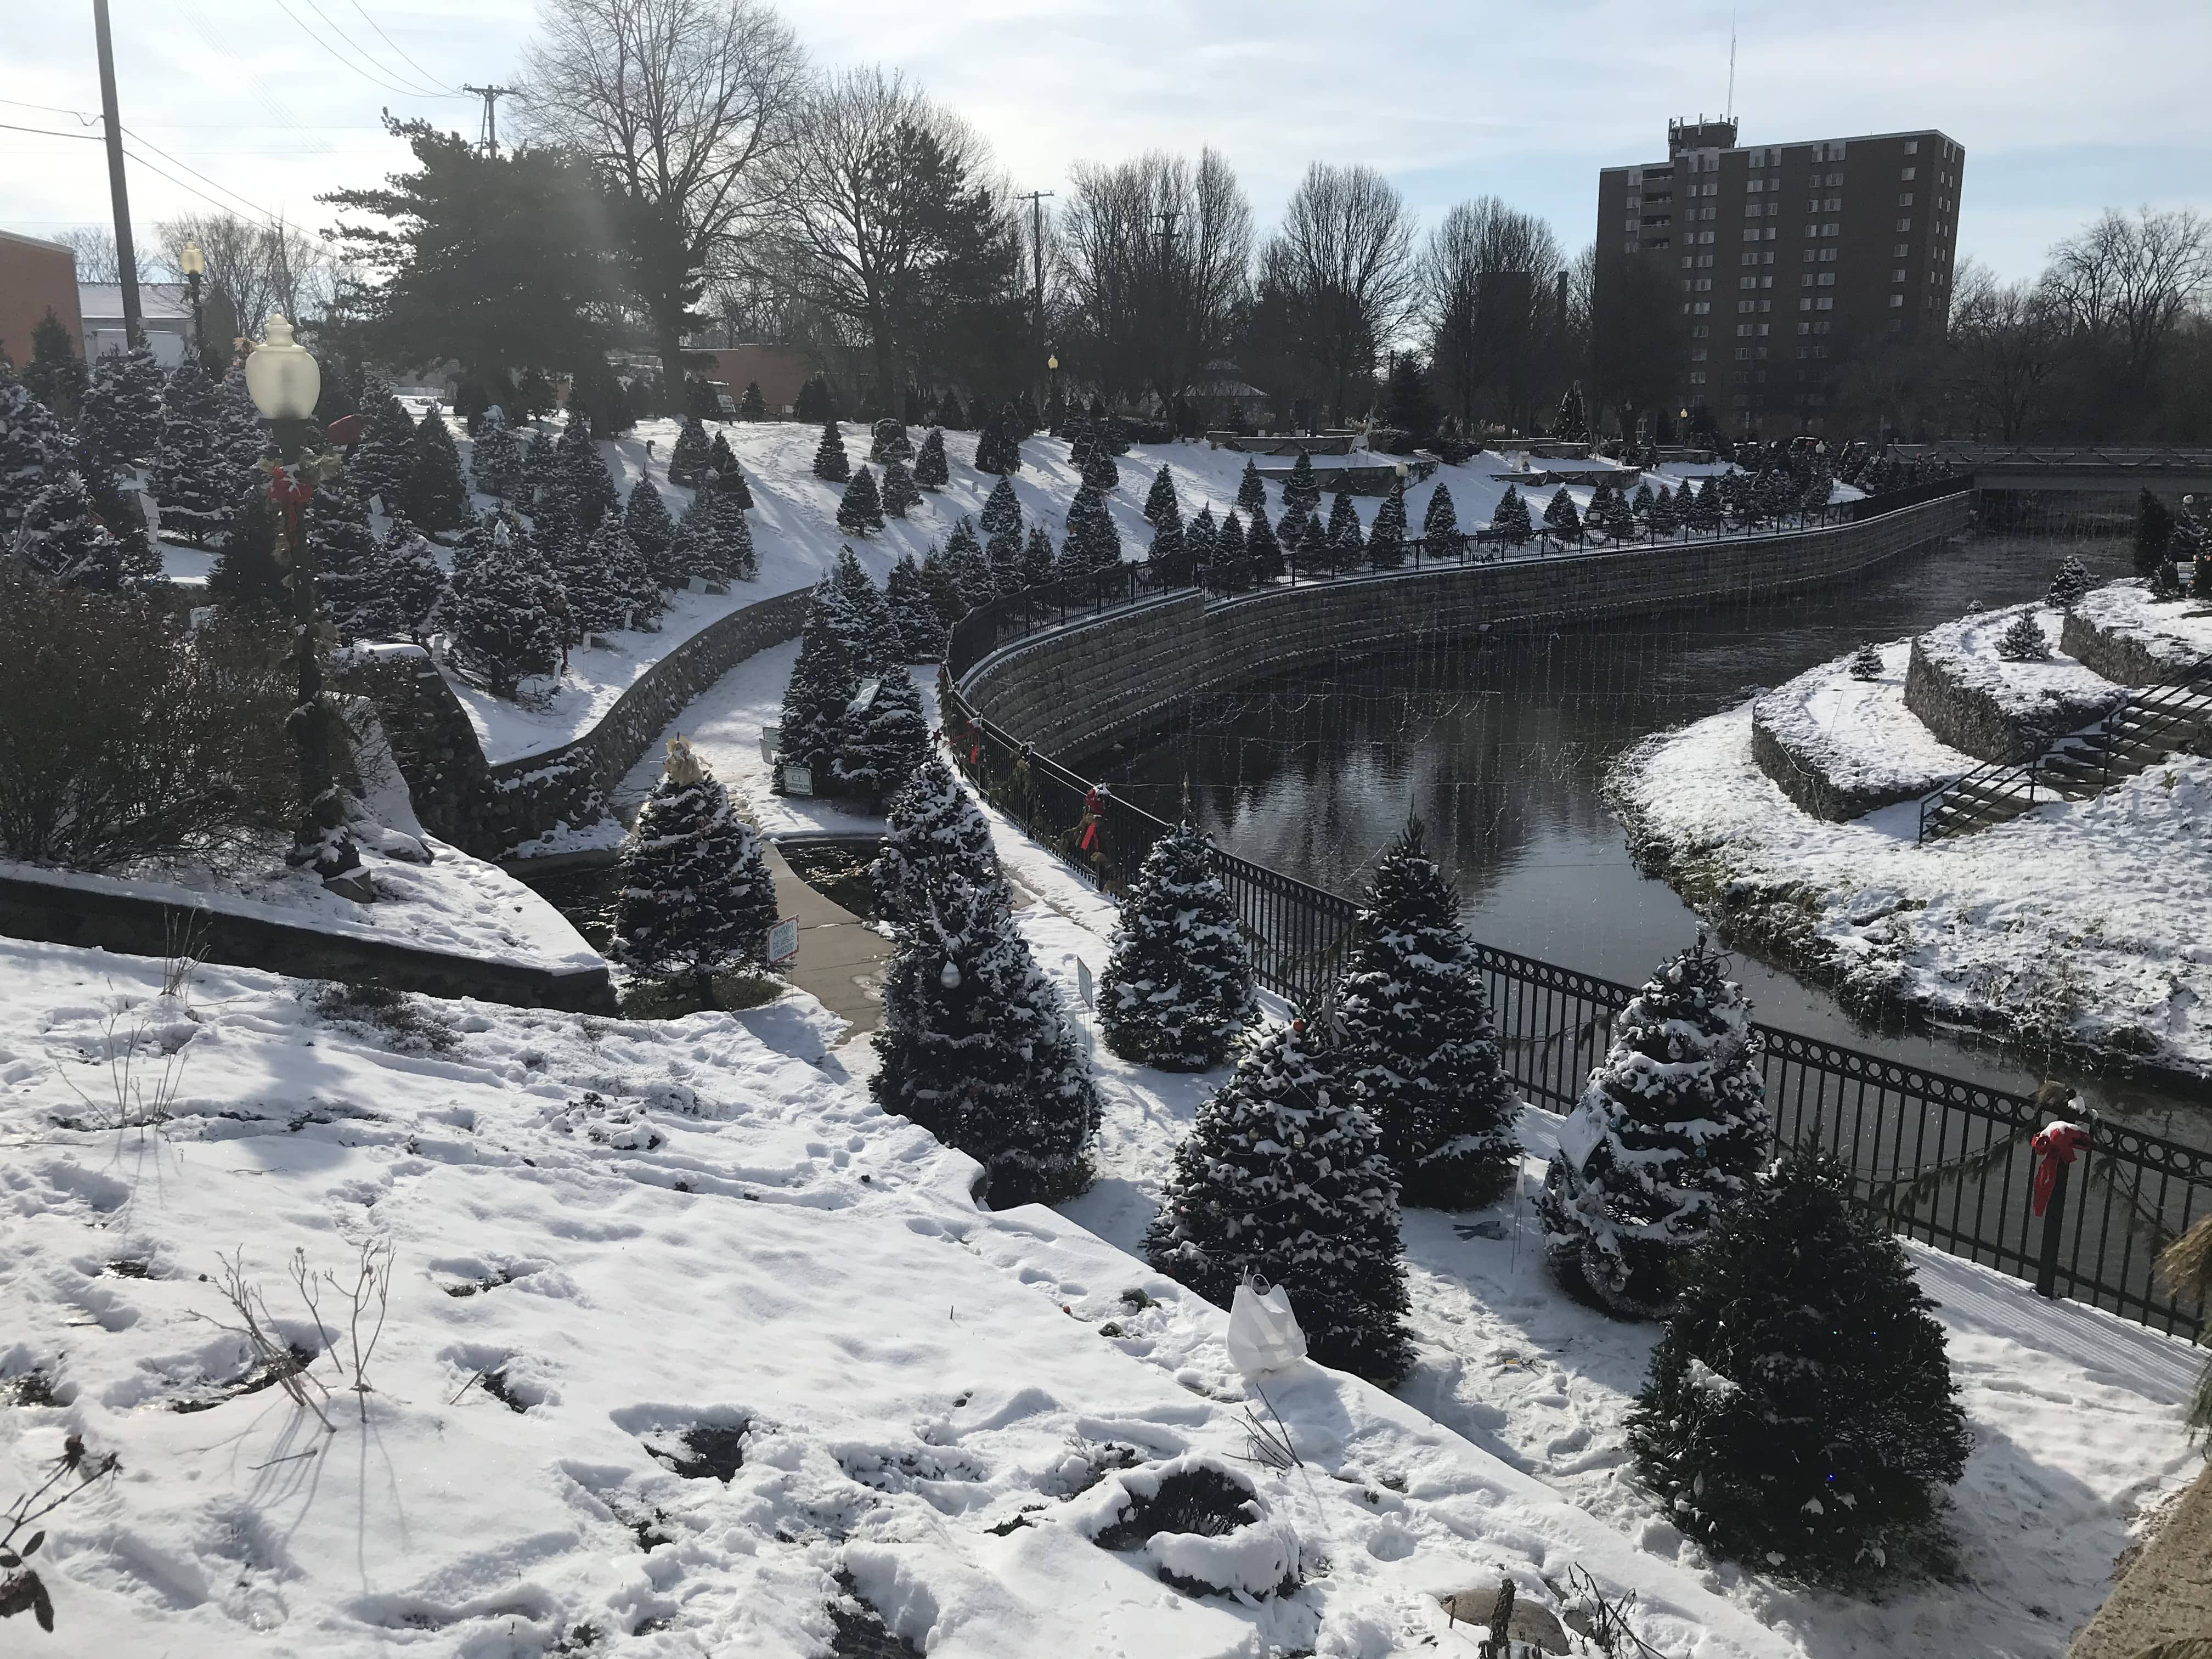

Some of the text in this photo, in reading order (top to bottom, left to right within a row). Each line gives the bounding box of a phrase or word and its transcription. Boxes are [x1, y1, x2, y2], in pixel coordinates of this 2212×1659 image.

[774, 922, 794, 939] MARIA
[772, 933, 795, 950] DE JESUS
[774, 942, 794, 957] OROZCO
